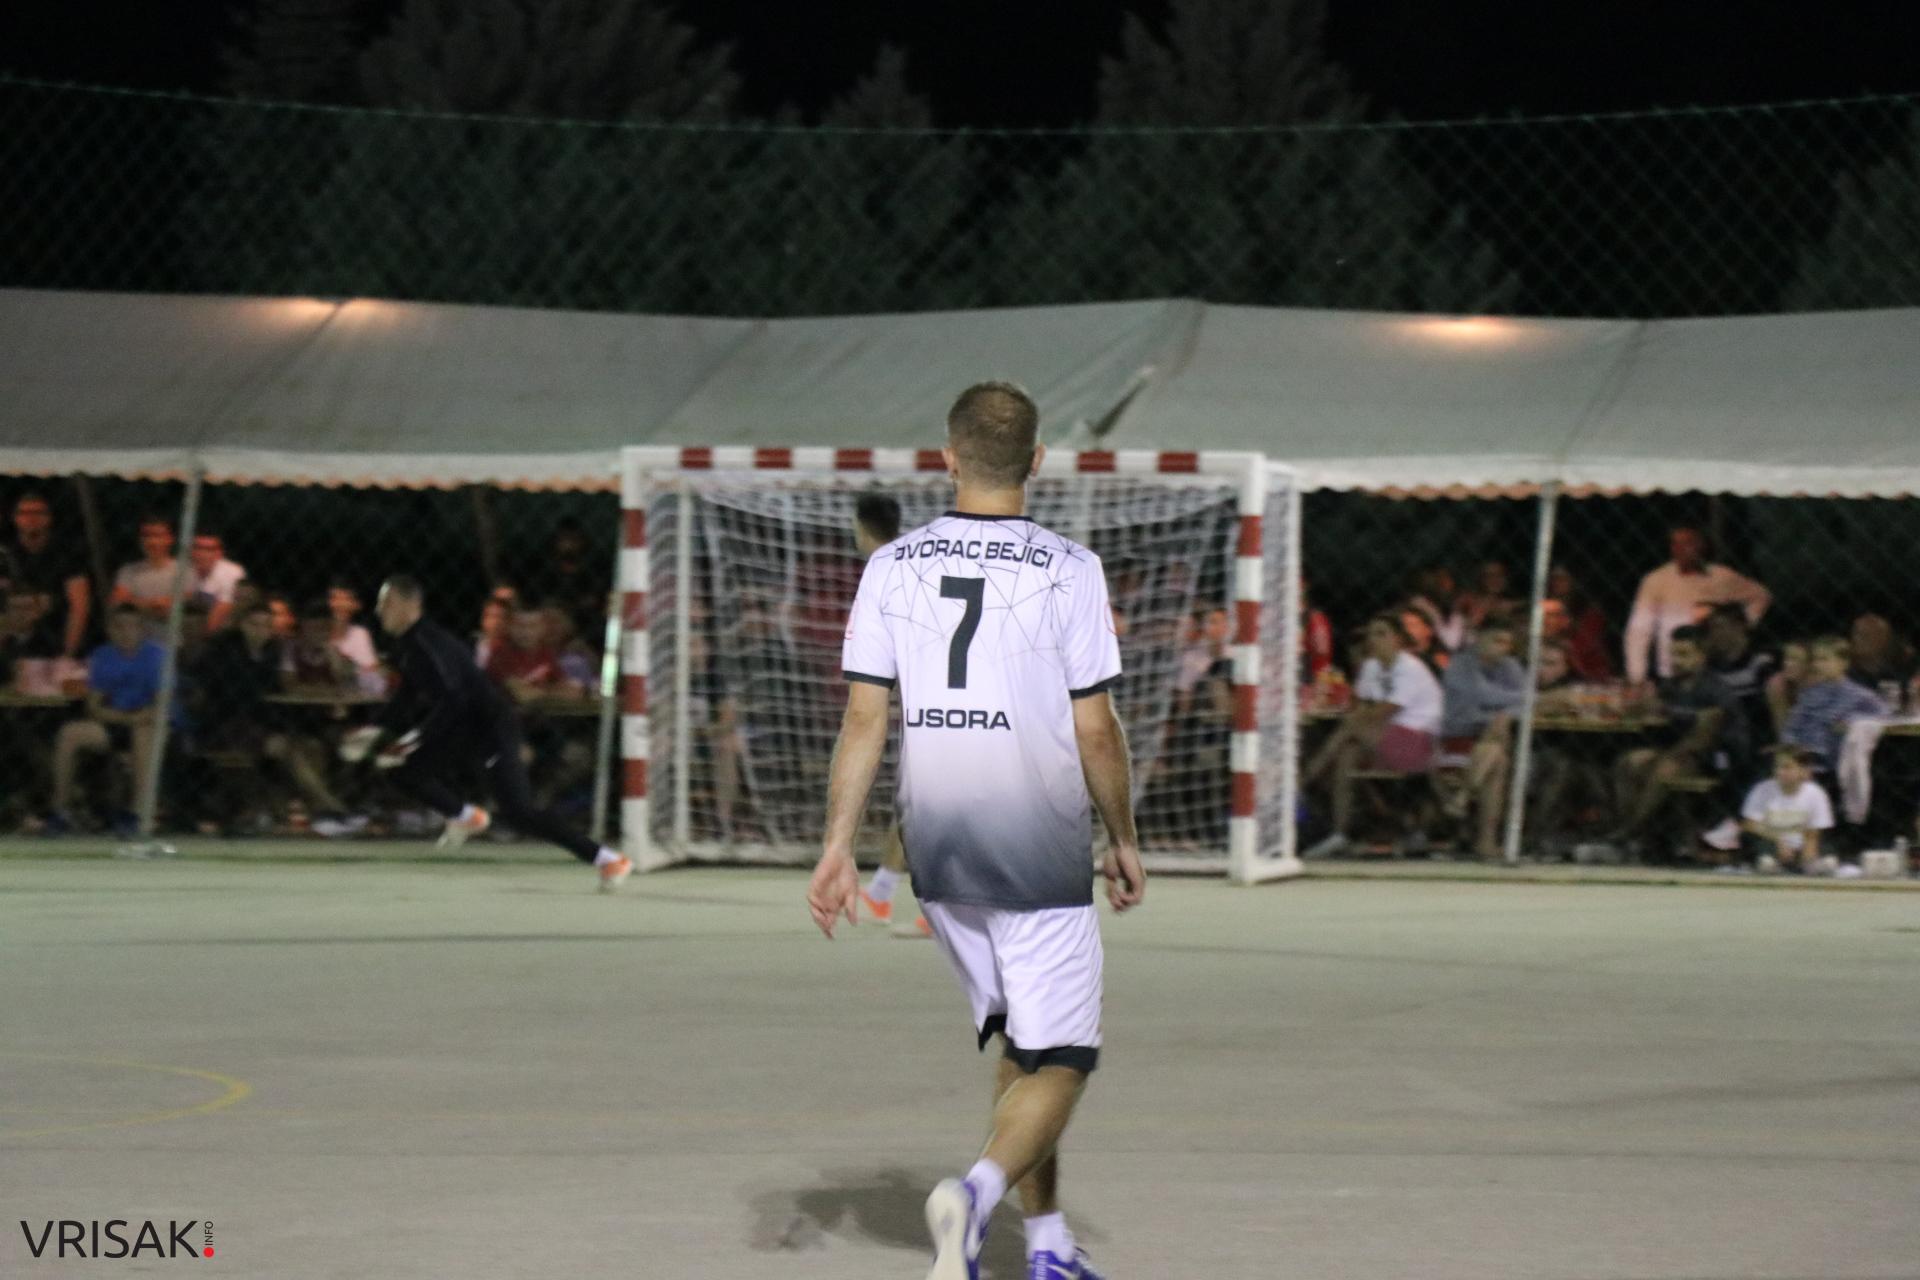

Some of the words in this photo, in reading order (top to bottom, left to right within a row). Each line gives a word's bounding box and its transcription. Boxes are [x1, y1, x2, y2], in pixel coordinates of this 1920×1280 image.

[985, 541, 1053, 569] BEJIĆI
[940, 575, 986, 689] 7
[906, 708, 1011, 731] USORA
